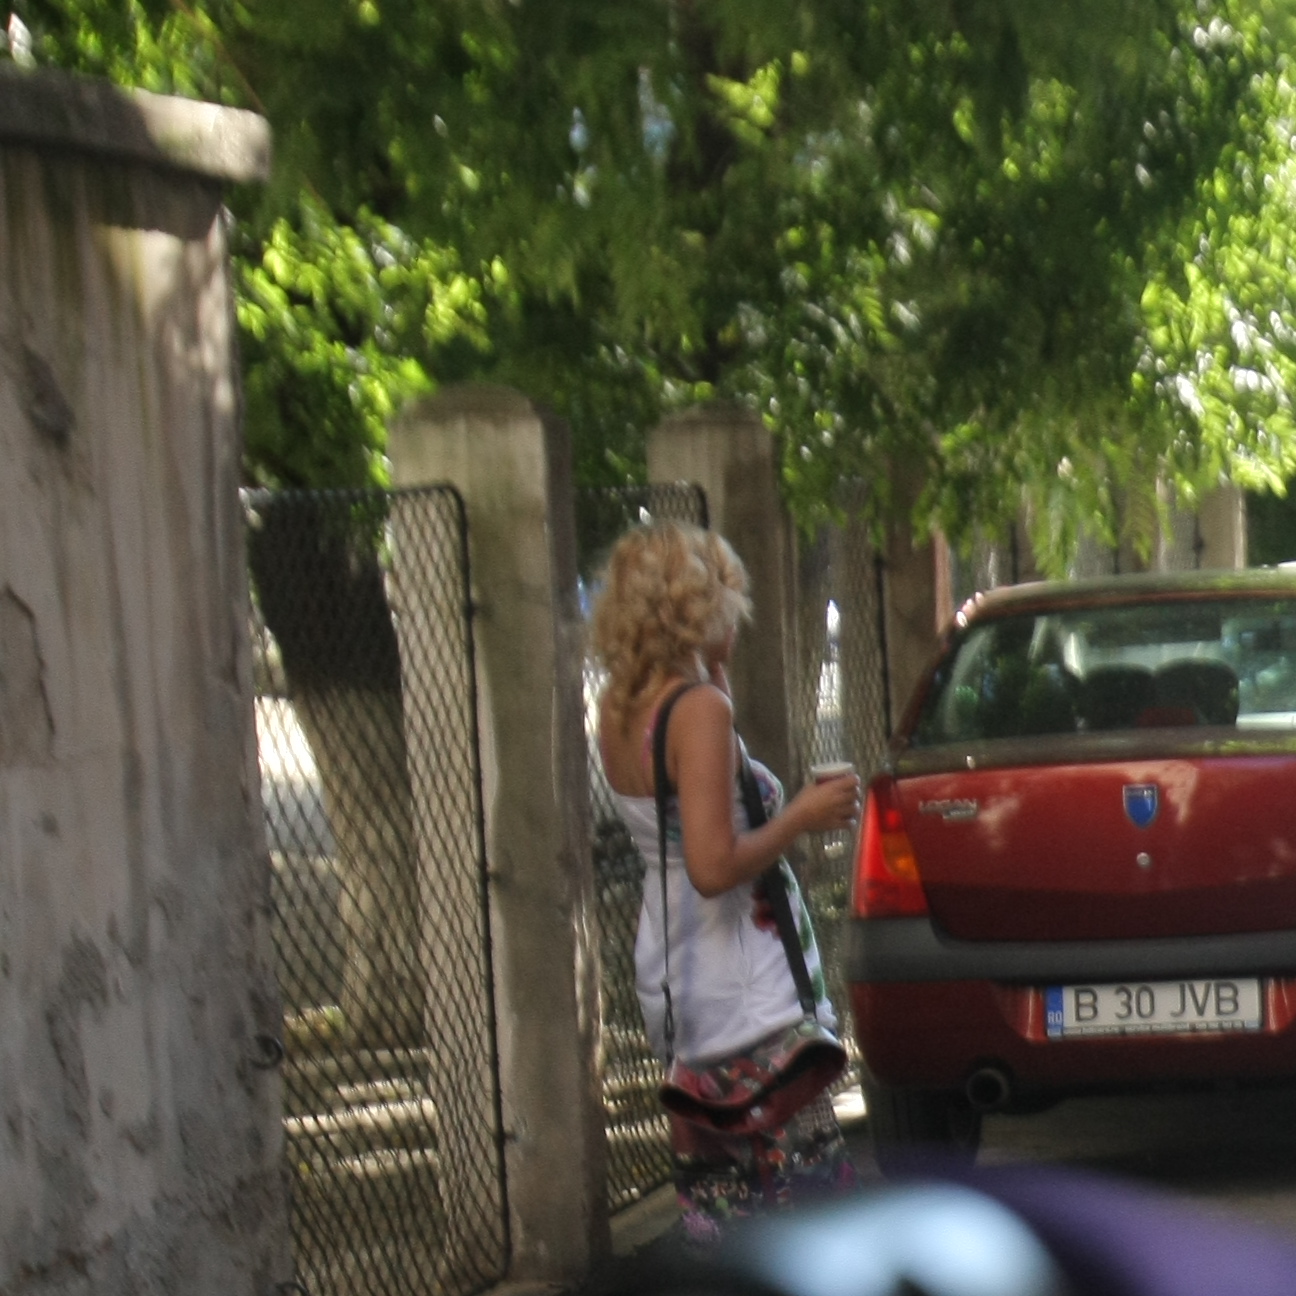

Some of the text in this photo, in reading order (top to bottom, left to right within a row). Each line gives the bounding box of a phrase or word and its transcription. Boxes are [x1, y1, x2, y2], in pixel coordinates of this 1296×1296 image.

[1074, 980, 1240, 1022] B 30 JVB
[1047, 1010, 1063, 1023] RO
